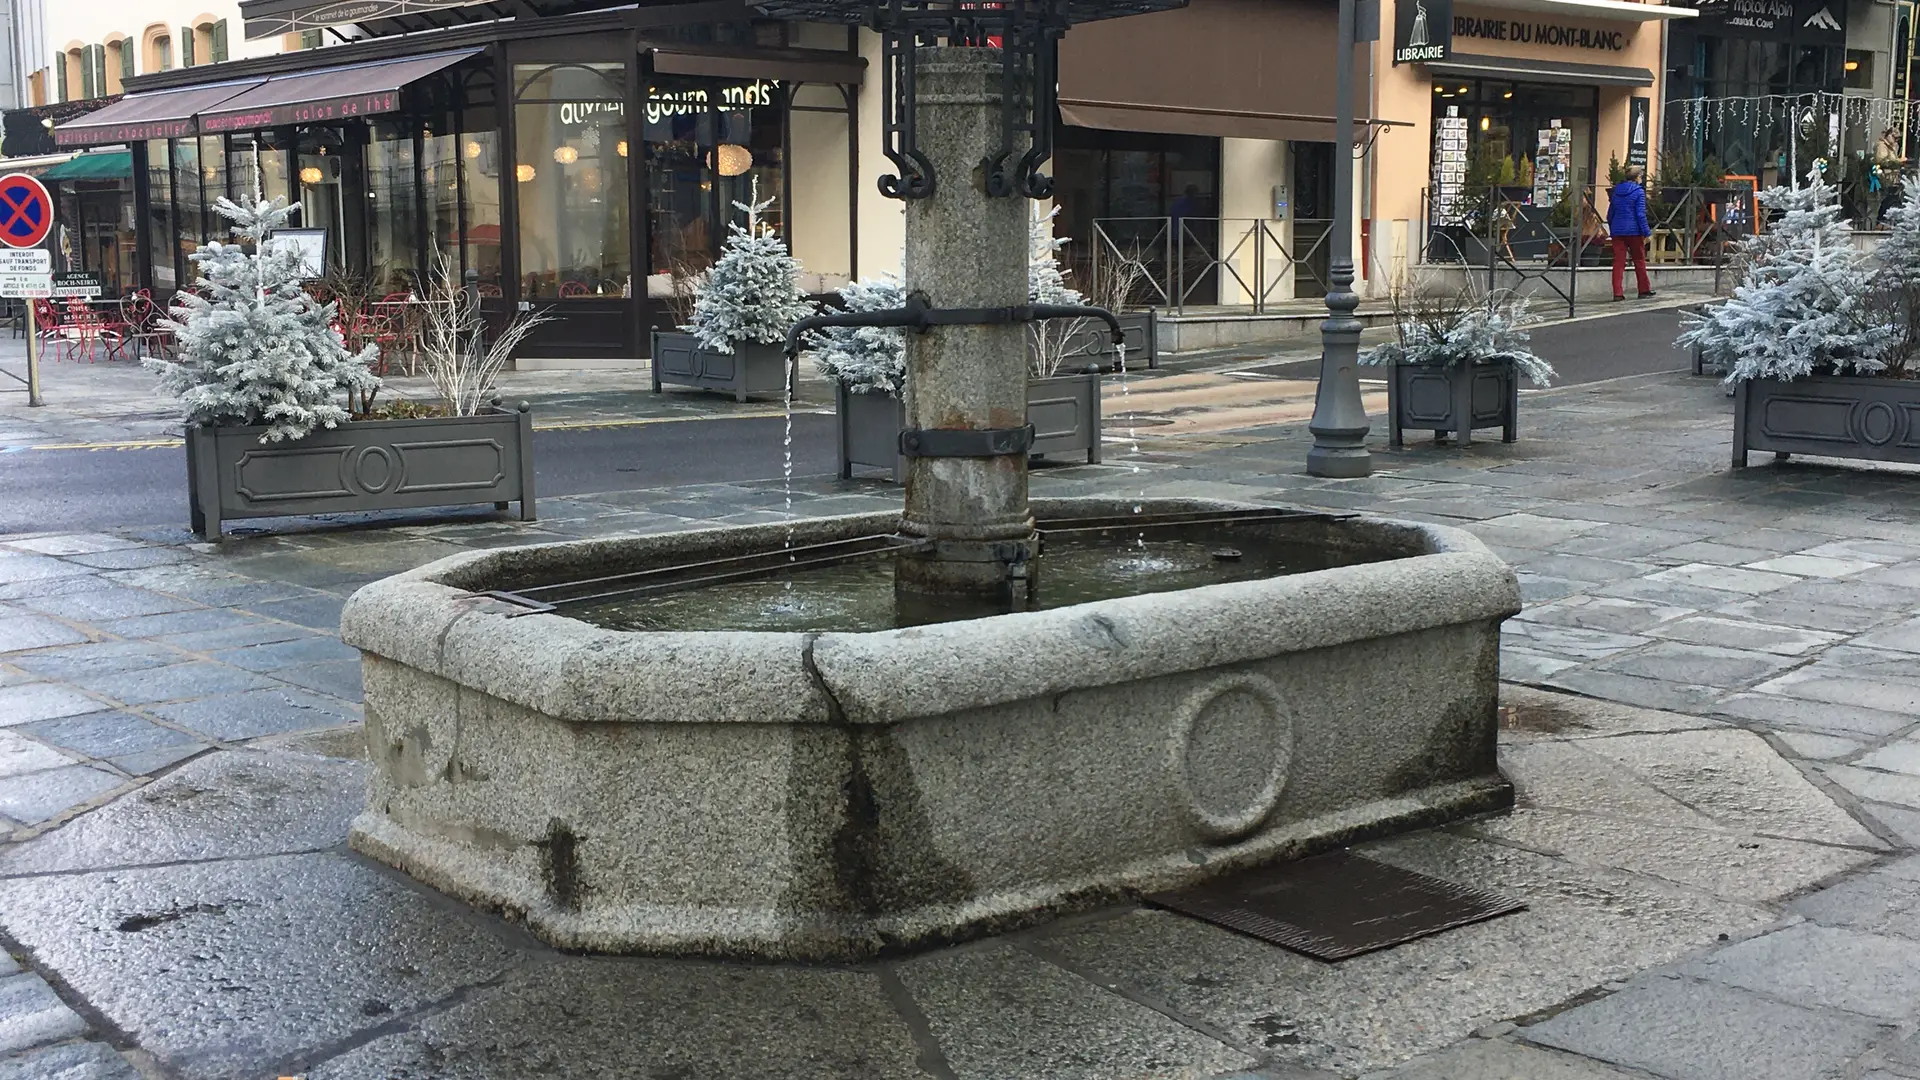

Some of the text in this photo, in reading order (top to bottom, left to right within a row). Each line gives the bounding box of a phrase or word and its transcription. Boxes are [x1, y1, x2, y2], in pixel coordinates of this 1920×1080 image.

[1733, 0, 1767, 15] mptoir
[1768, 1, 1793, 19] Alpin
[1510, 22, 1532, 42] DU
[1535, 26, 1622, 50] MONT-BLANC
[1397, 46, 1444, 61] LIBRAIRIE
[295, 94, 391, 121] salon de thé
[57, 288, 100, 296] IMMOBILIER
